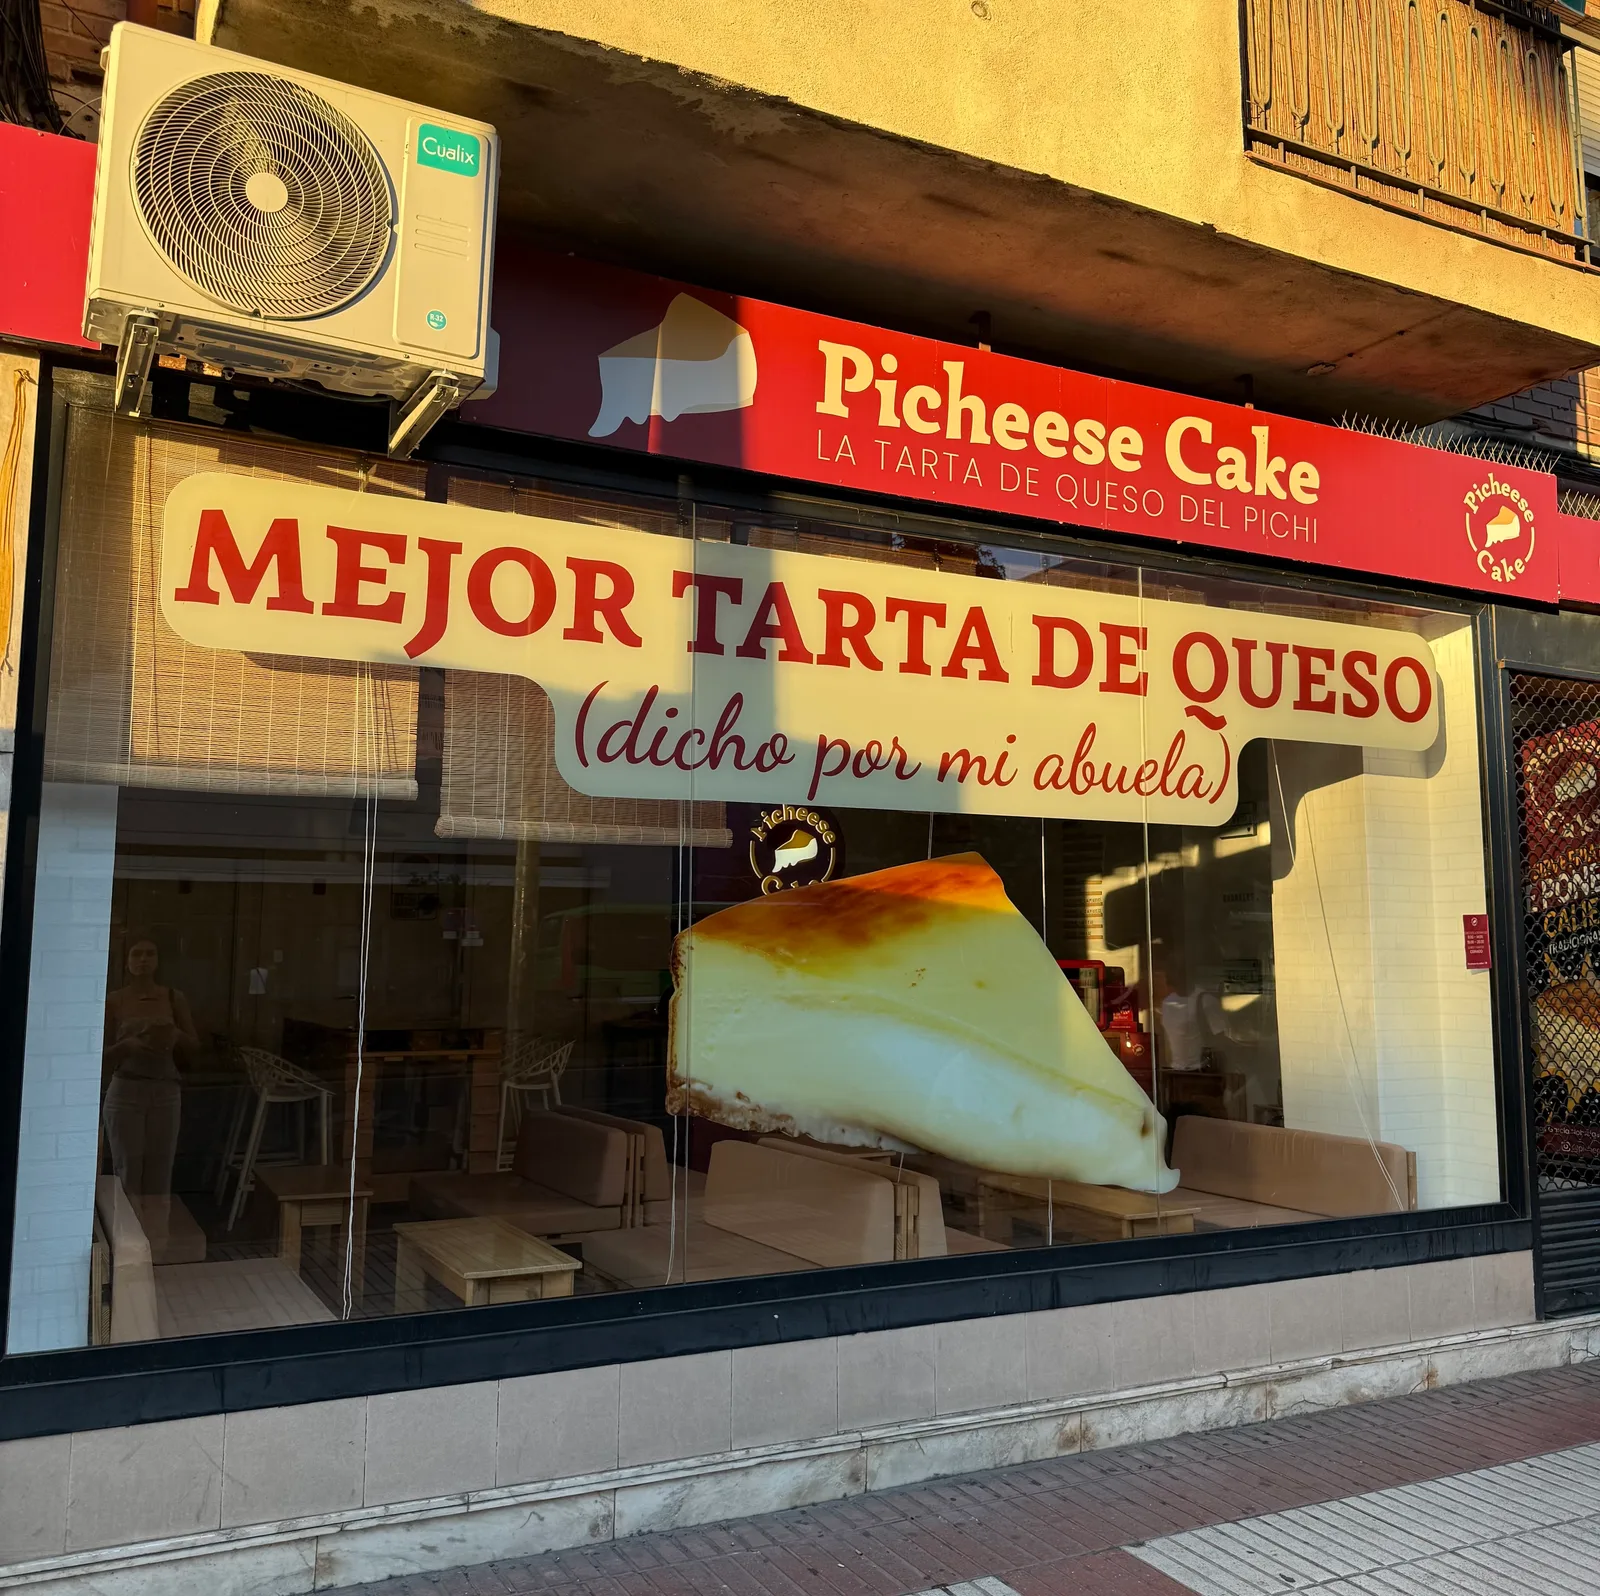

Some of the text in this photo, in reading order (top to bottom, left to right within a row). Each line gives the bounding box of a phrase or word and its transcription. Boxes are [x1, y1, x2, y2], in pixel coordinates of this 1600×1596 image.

[422, 136, 475, 166] Cualix
[429, 313, 444, 323] R-32
[816, 340, 1321, 505] Picheese Cake
[817, 428, 1318, 544] LA TARTA DE QUESO DEL PICHI
[1463, 472, 1535, 523] Picheese
[1477, 549, 1526, 583] Cake
[174, 509, 1432, 731] MEJOR TARTA DE QUESO
[574, 680, 1231, 805] (dicho por mi abuela)
